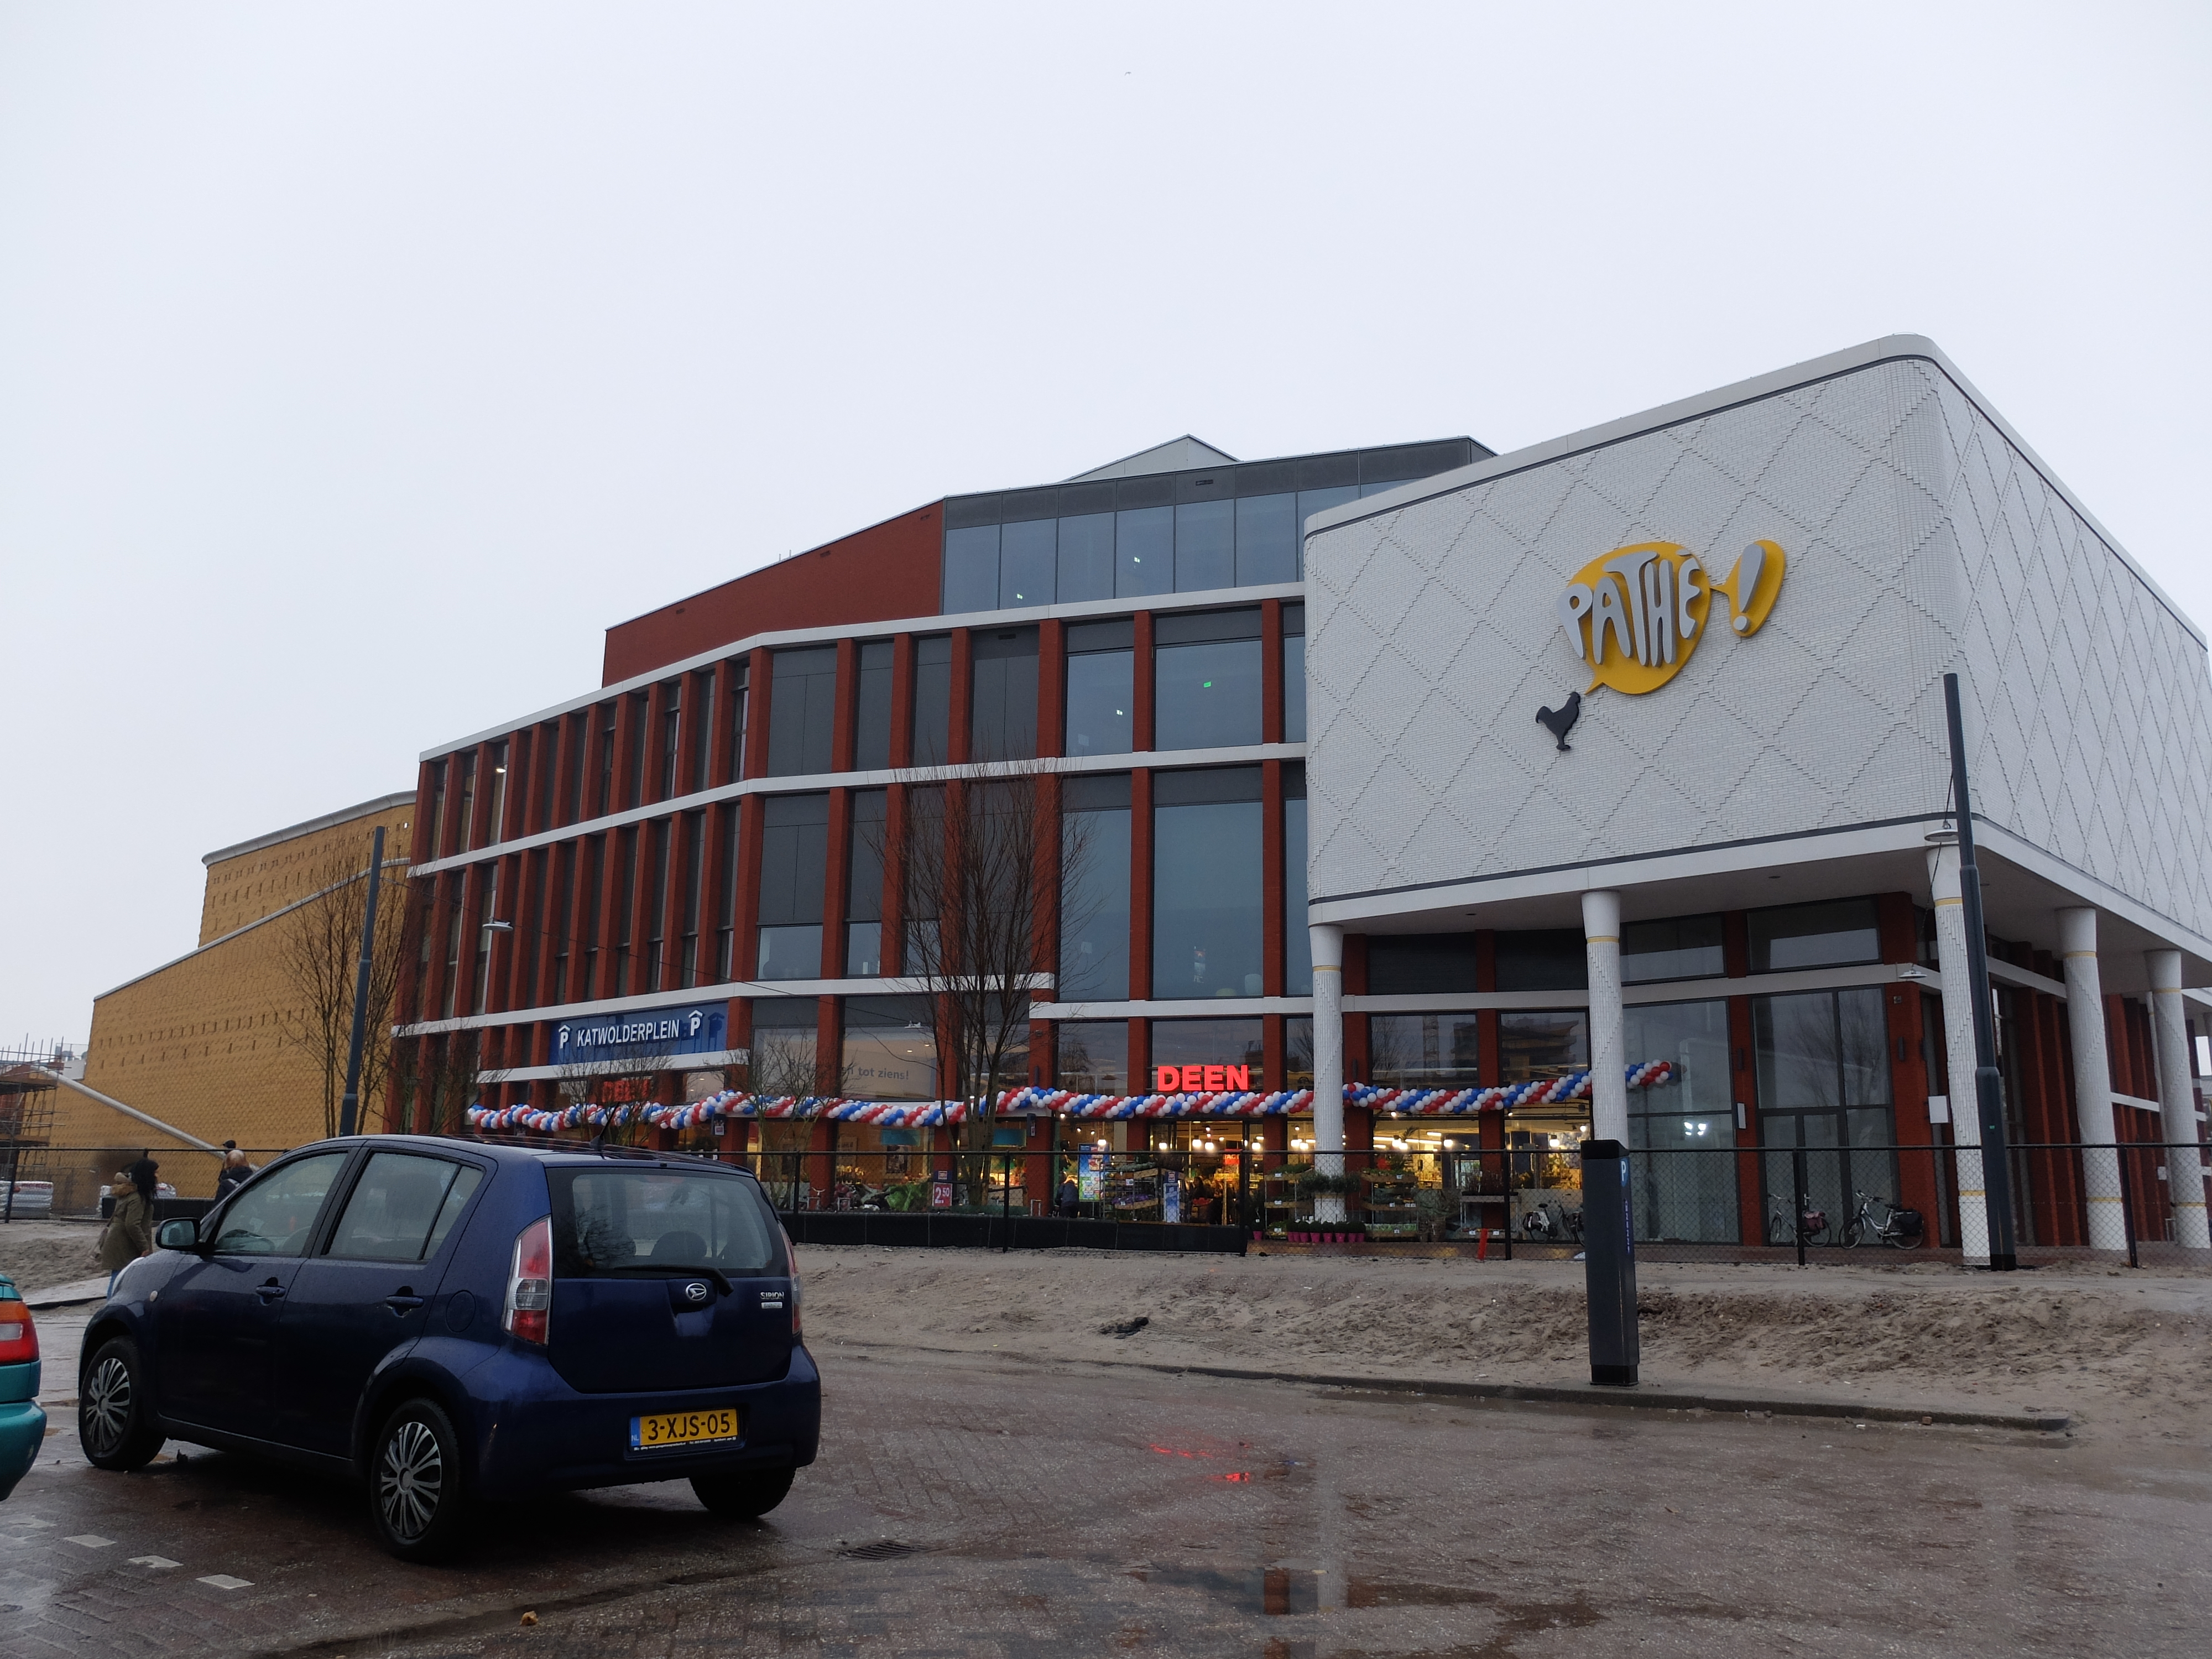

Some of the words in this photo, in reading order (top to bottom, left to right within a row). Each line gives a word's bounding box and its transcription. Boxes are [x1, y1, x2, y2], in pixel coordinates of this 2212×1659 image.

[577, 1019, 680, 1047] KATWOLDERPLEIN
[858, 1067, 874, 1077] tot
[878, 1068, 909, 1080] ziens!
[1157, 1065, 1248, 1091] DEEN
[1621, 1160, 1626, 1182] P
[760, 1291, 784, 1300] SIRION
[648, 1412, 731, 1441] 3-XJS-05
